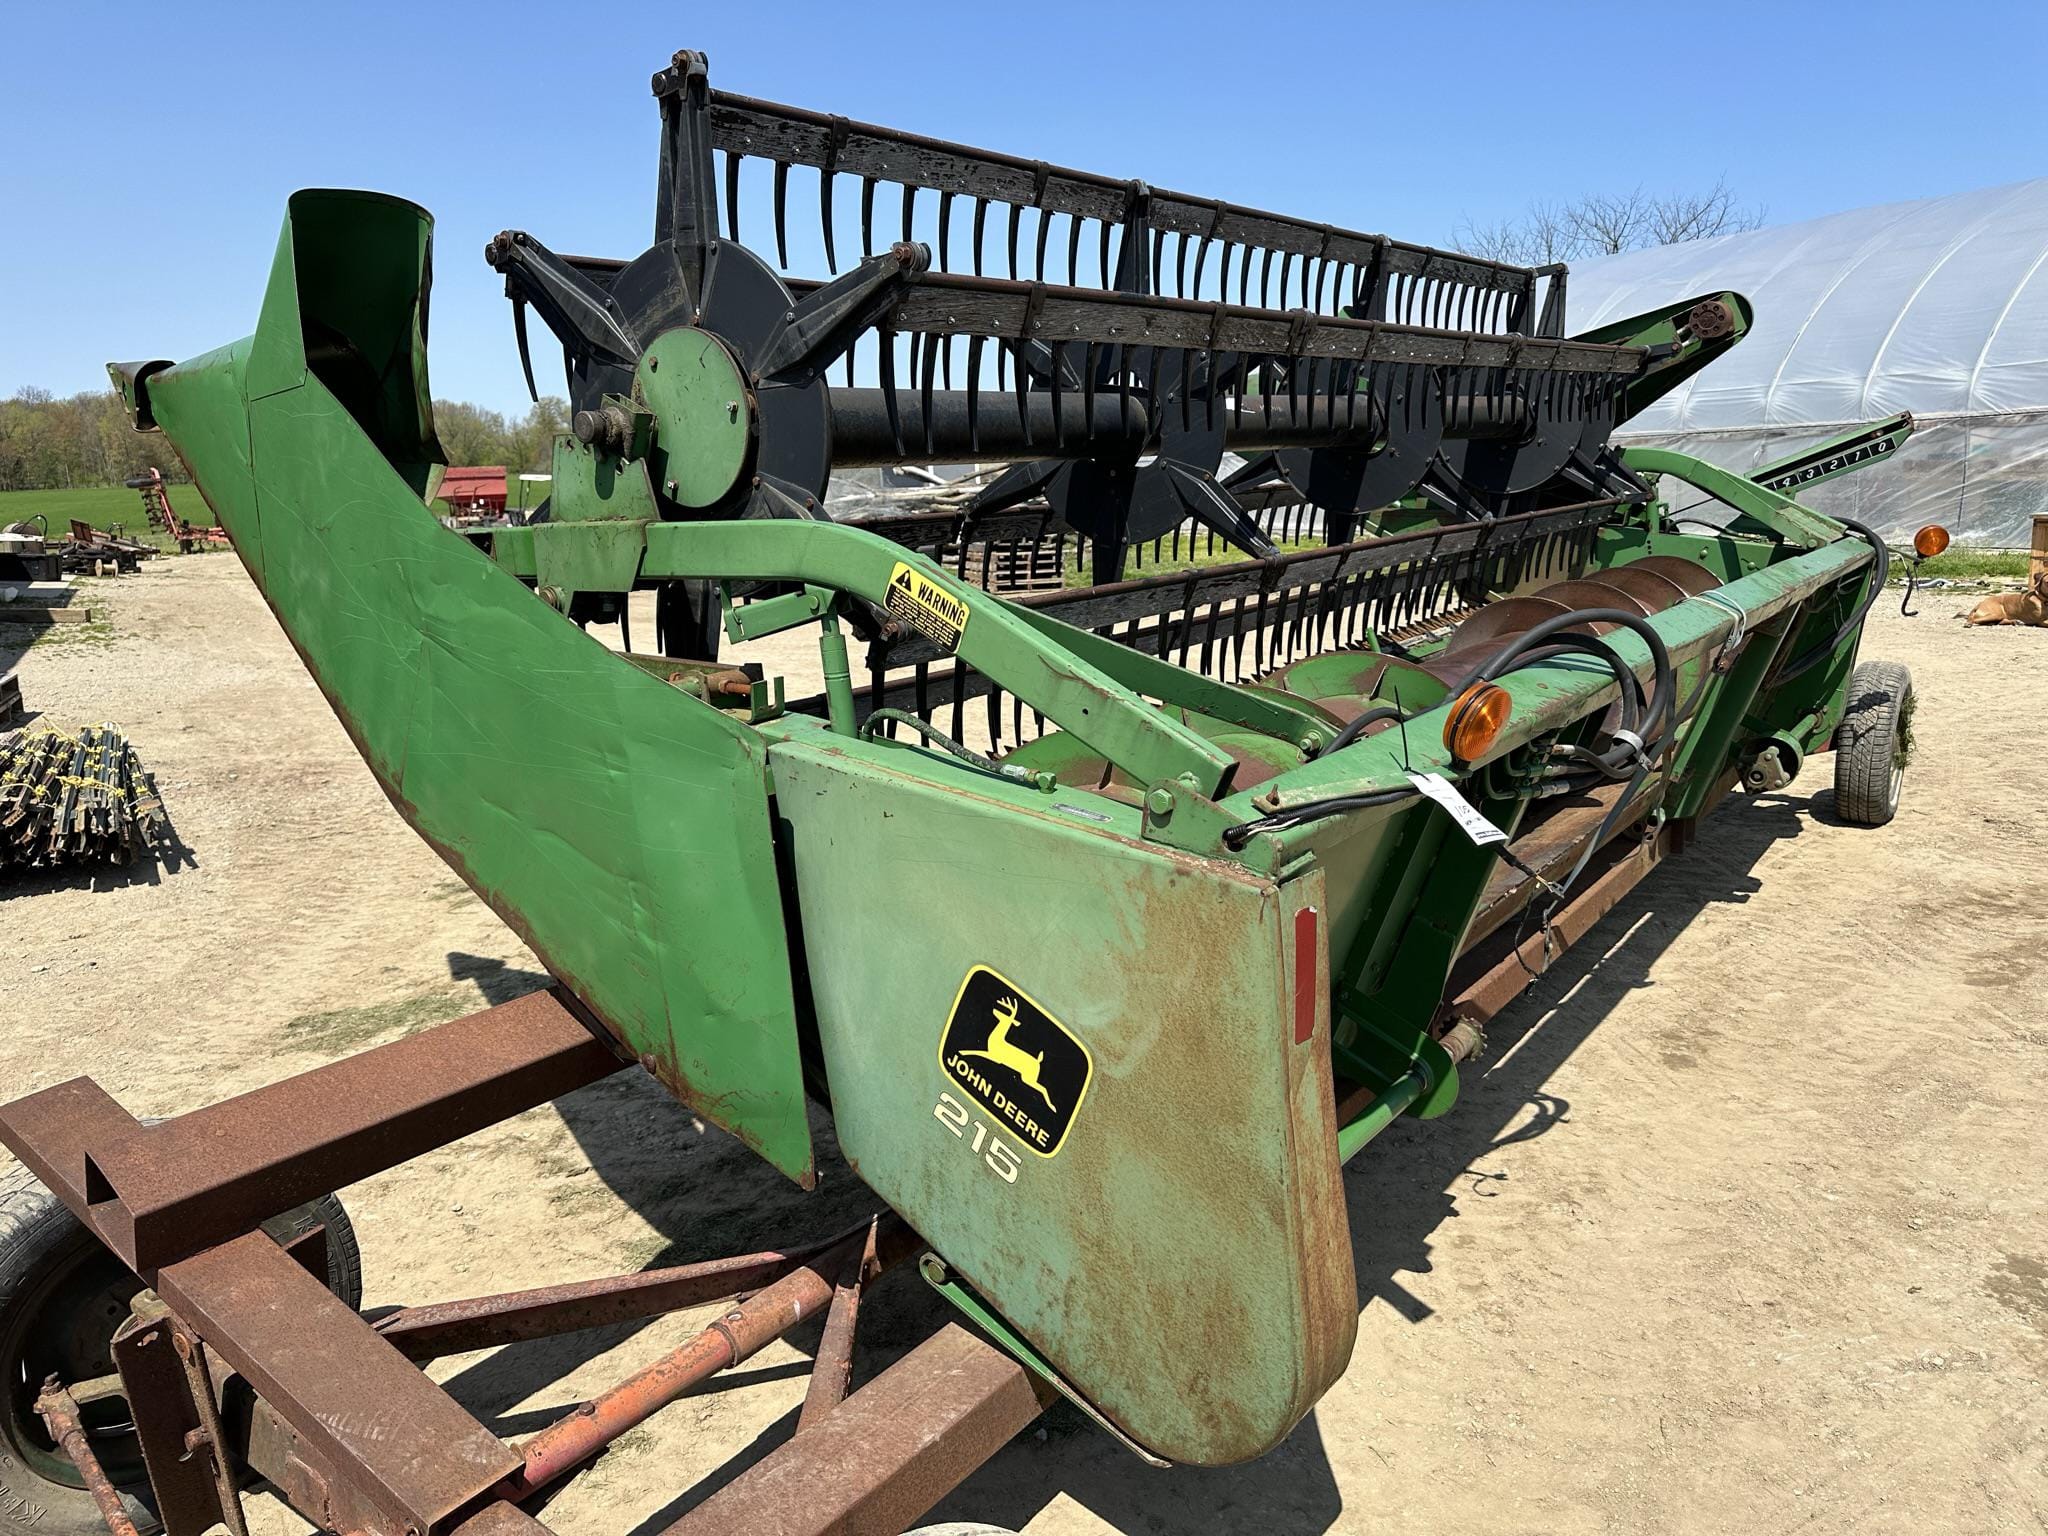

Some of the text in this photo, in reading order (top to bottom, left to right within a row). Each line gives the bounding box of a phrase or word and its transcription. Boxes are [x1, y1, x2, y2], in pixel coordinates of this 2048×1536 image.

[1782, 441, 1887, 488] 4 3 2 1 0
[917, 582, 966, 626] WARNING
[947, 1054, 1050, 1148] JOHN DEERE
[933, 1091, 1022, 1184] 215
